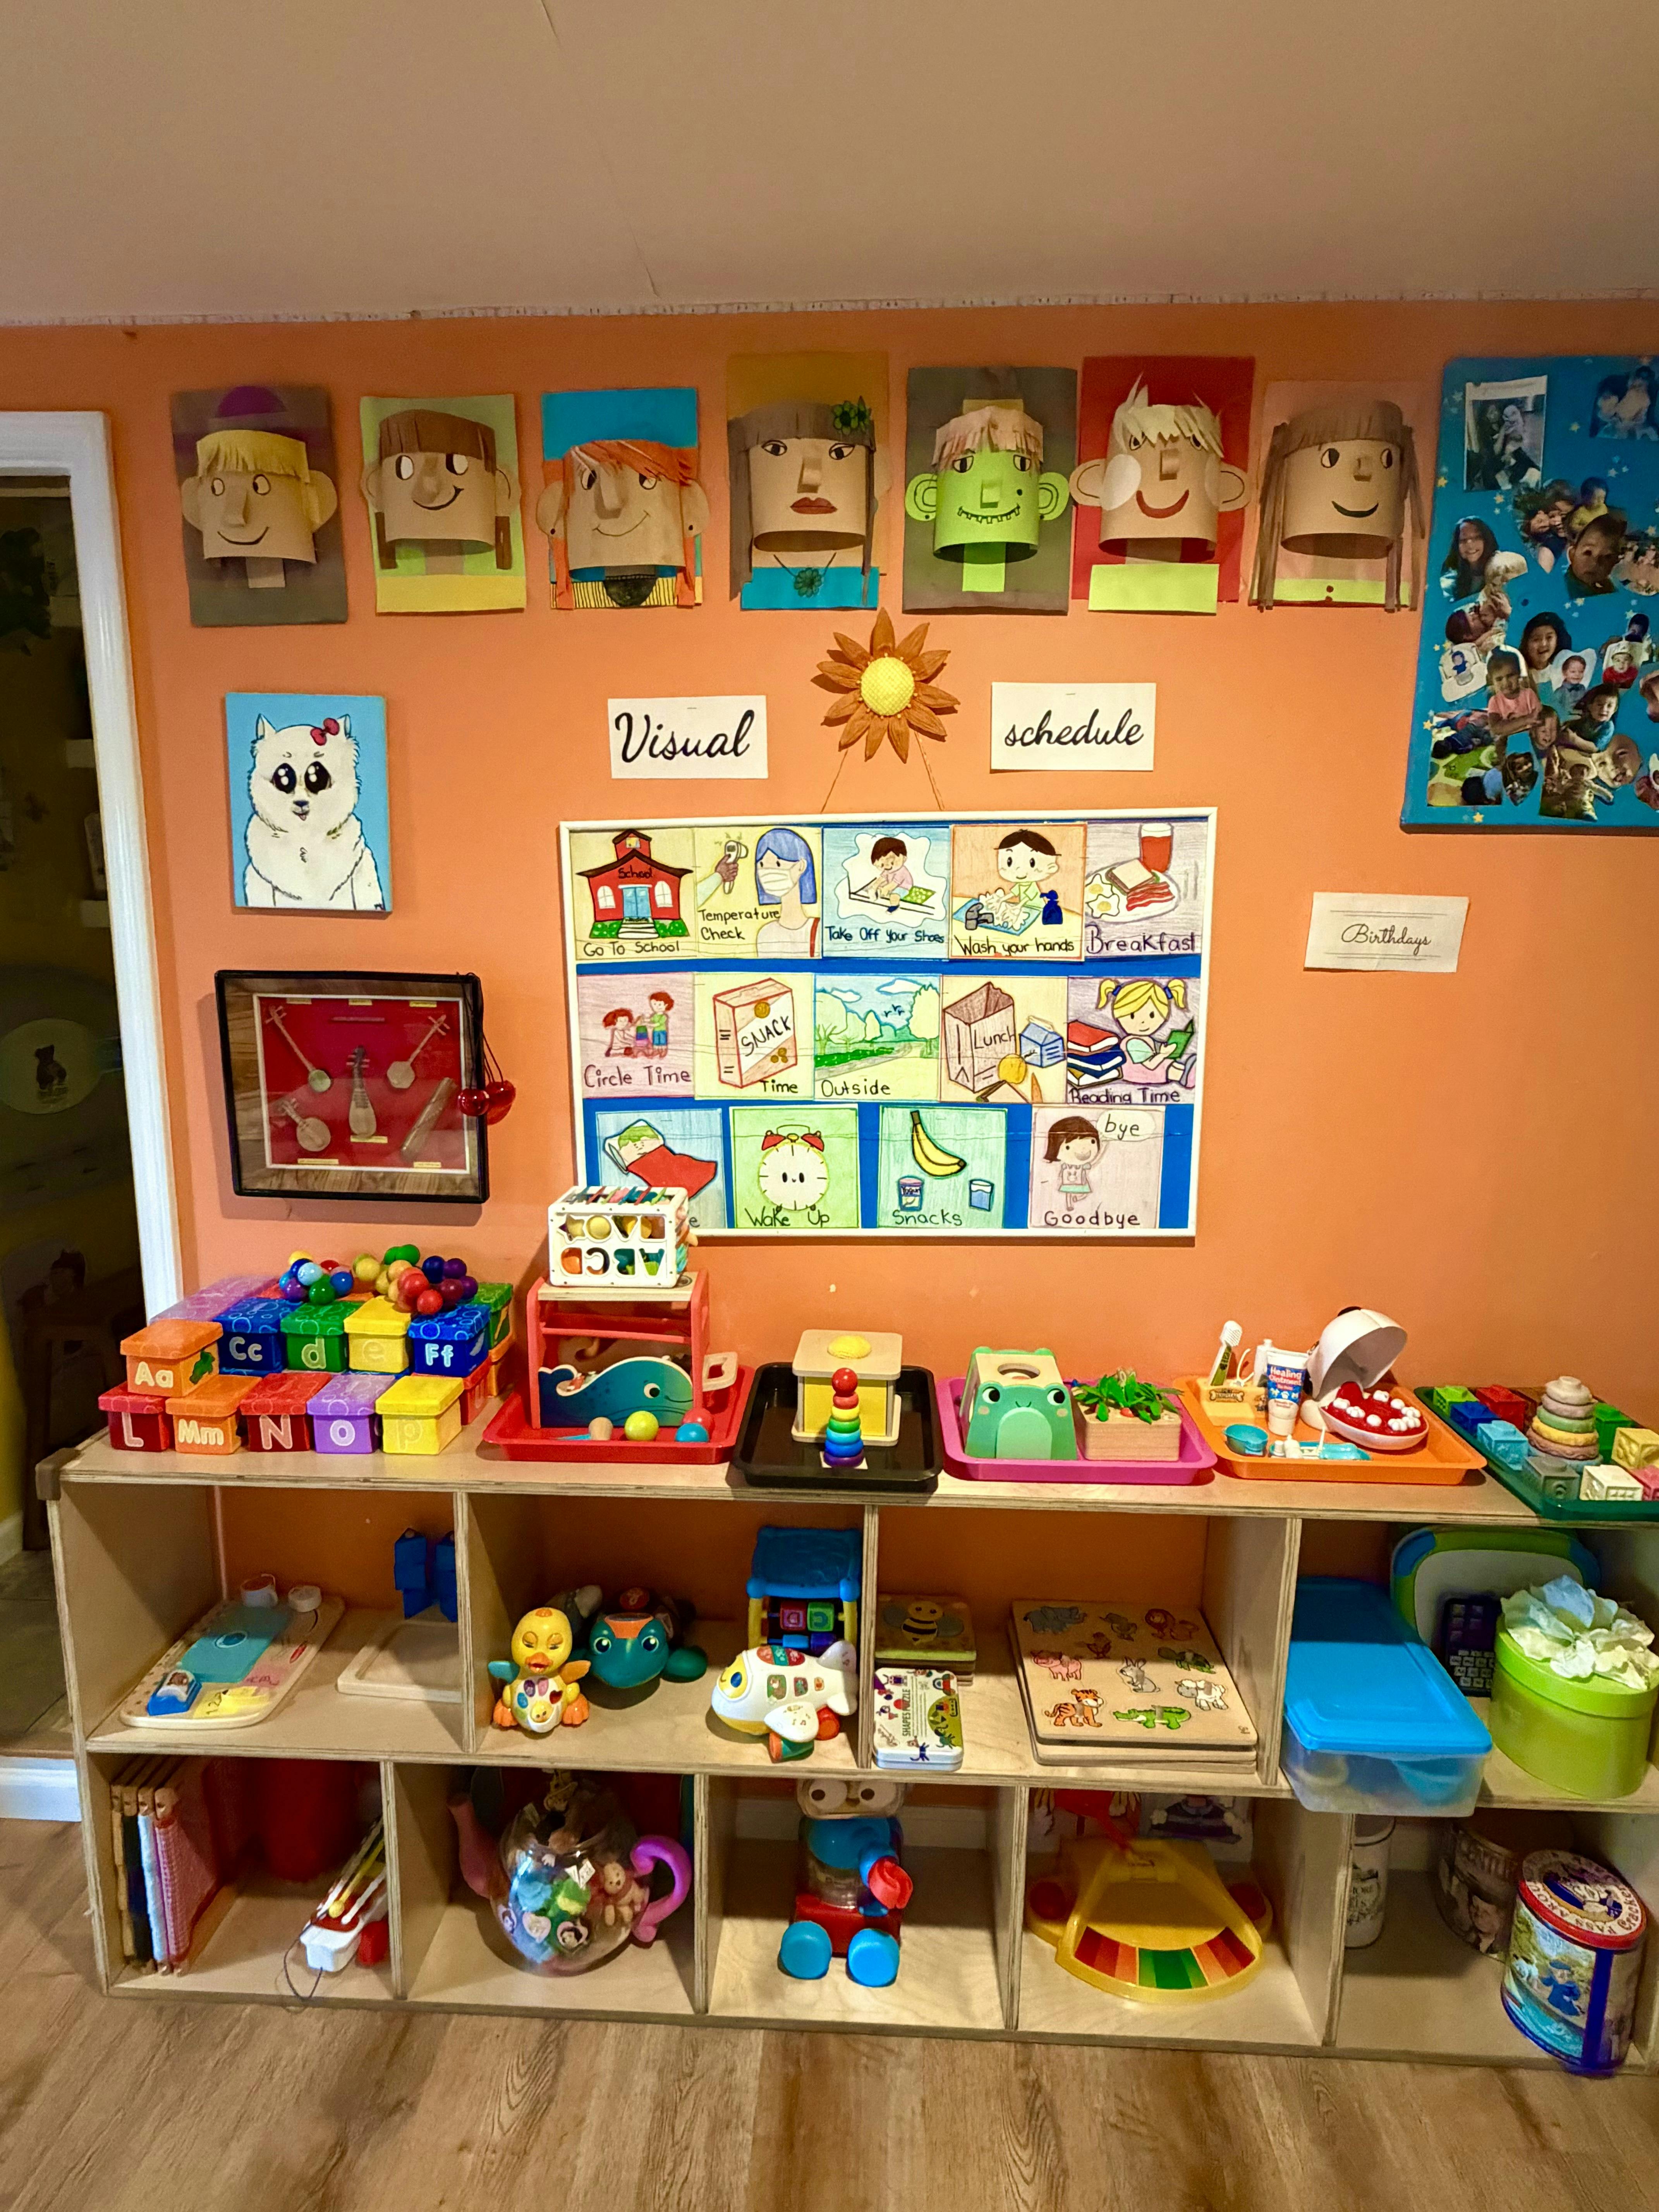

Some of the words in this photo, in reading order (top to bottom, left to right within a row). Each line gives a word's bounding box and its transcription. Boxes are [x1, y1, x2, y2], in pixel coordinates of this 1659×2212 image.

[615, 709, 756, 763] Visual
[1005, 708, 1144, 748] schedule
[618, 866, 653, 879] School
[698, 909, 780, 924] Temperature
[701, 927, 745, 941] Check
[825, 926, 853, 941] Take
[860, 927, 881, 940] Off
[915, 929, 945, 943] Shoes
[1085, 924, 1195, 954] Breakfast
[1341, 924, 1431, 955] Birthdays
[584, 943, 603, 956] Go
[610, 941, 625, 955] To
[635, 940, 680, 953] School
[954, 935, 996, 956] Wash
[1002, 942, 1029, 957] your
[1034, 937, 1074, 953] hands
[740, 1015, 792, 1056] SNACK
[974, 1026, 1017, 1049] Lunch
[584, 1065, 632, 1087] Circle
[644, 1065, 692, 1086] Time
[759, 1079, 799, 1094] Time
[821, 1079, 891, 1097] Outside
[1069, 1088, 1132, 1104] Reading
[1137, 1087, 1180, 1103] Time
[1105, 1114, 1140, 1140] bye
[744, 1207, 790, 1227] Wake
[807, 1209, 830, 1228] Up
[892, 1210, 963, 1226] Snacks
[1044, 1211, 1140, 1229] Goodbye
[229, 1336, 263, 1361] Cc
[301, 1336, 326, 1369] d
[363, 1339, 386, 1362] e
[425, 1343, 453, 1367] Ff
[135, 1361, 173, 1388] Aa
[1271, 1366, 1302, 1380] Healing
[122, 1412, 144, 1447] L
[178, 1419, 224, 1446] Mm
[259, 1414, 293, 1450] N
[902, 1689, 910, 1711] PUZZLE
[902, 1712, 910, 1736] SHAPES
[1617, 1884, 1639, 1930] Cracker
